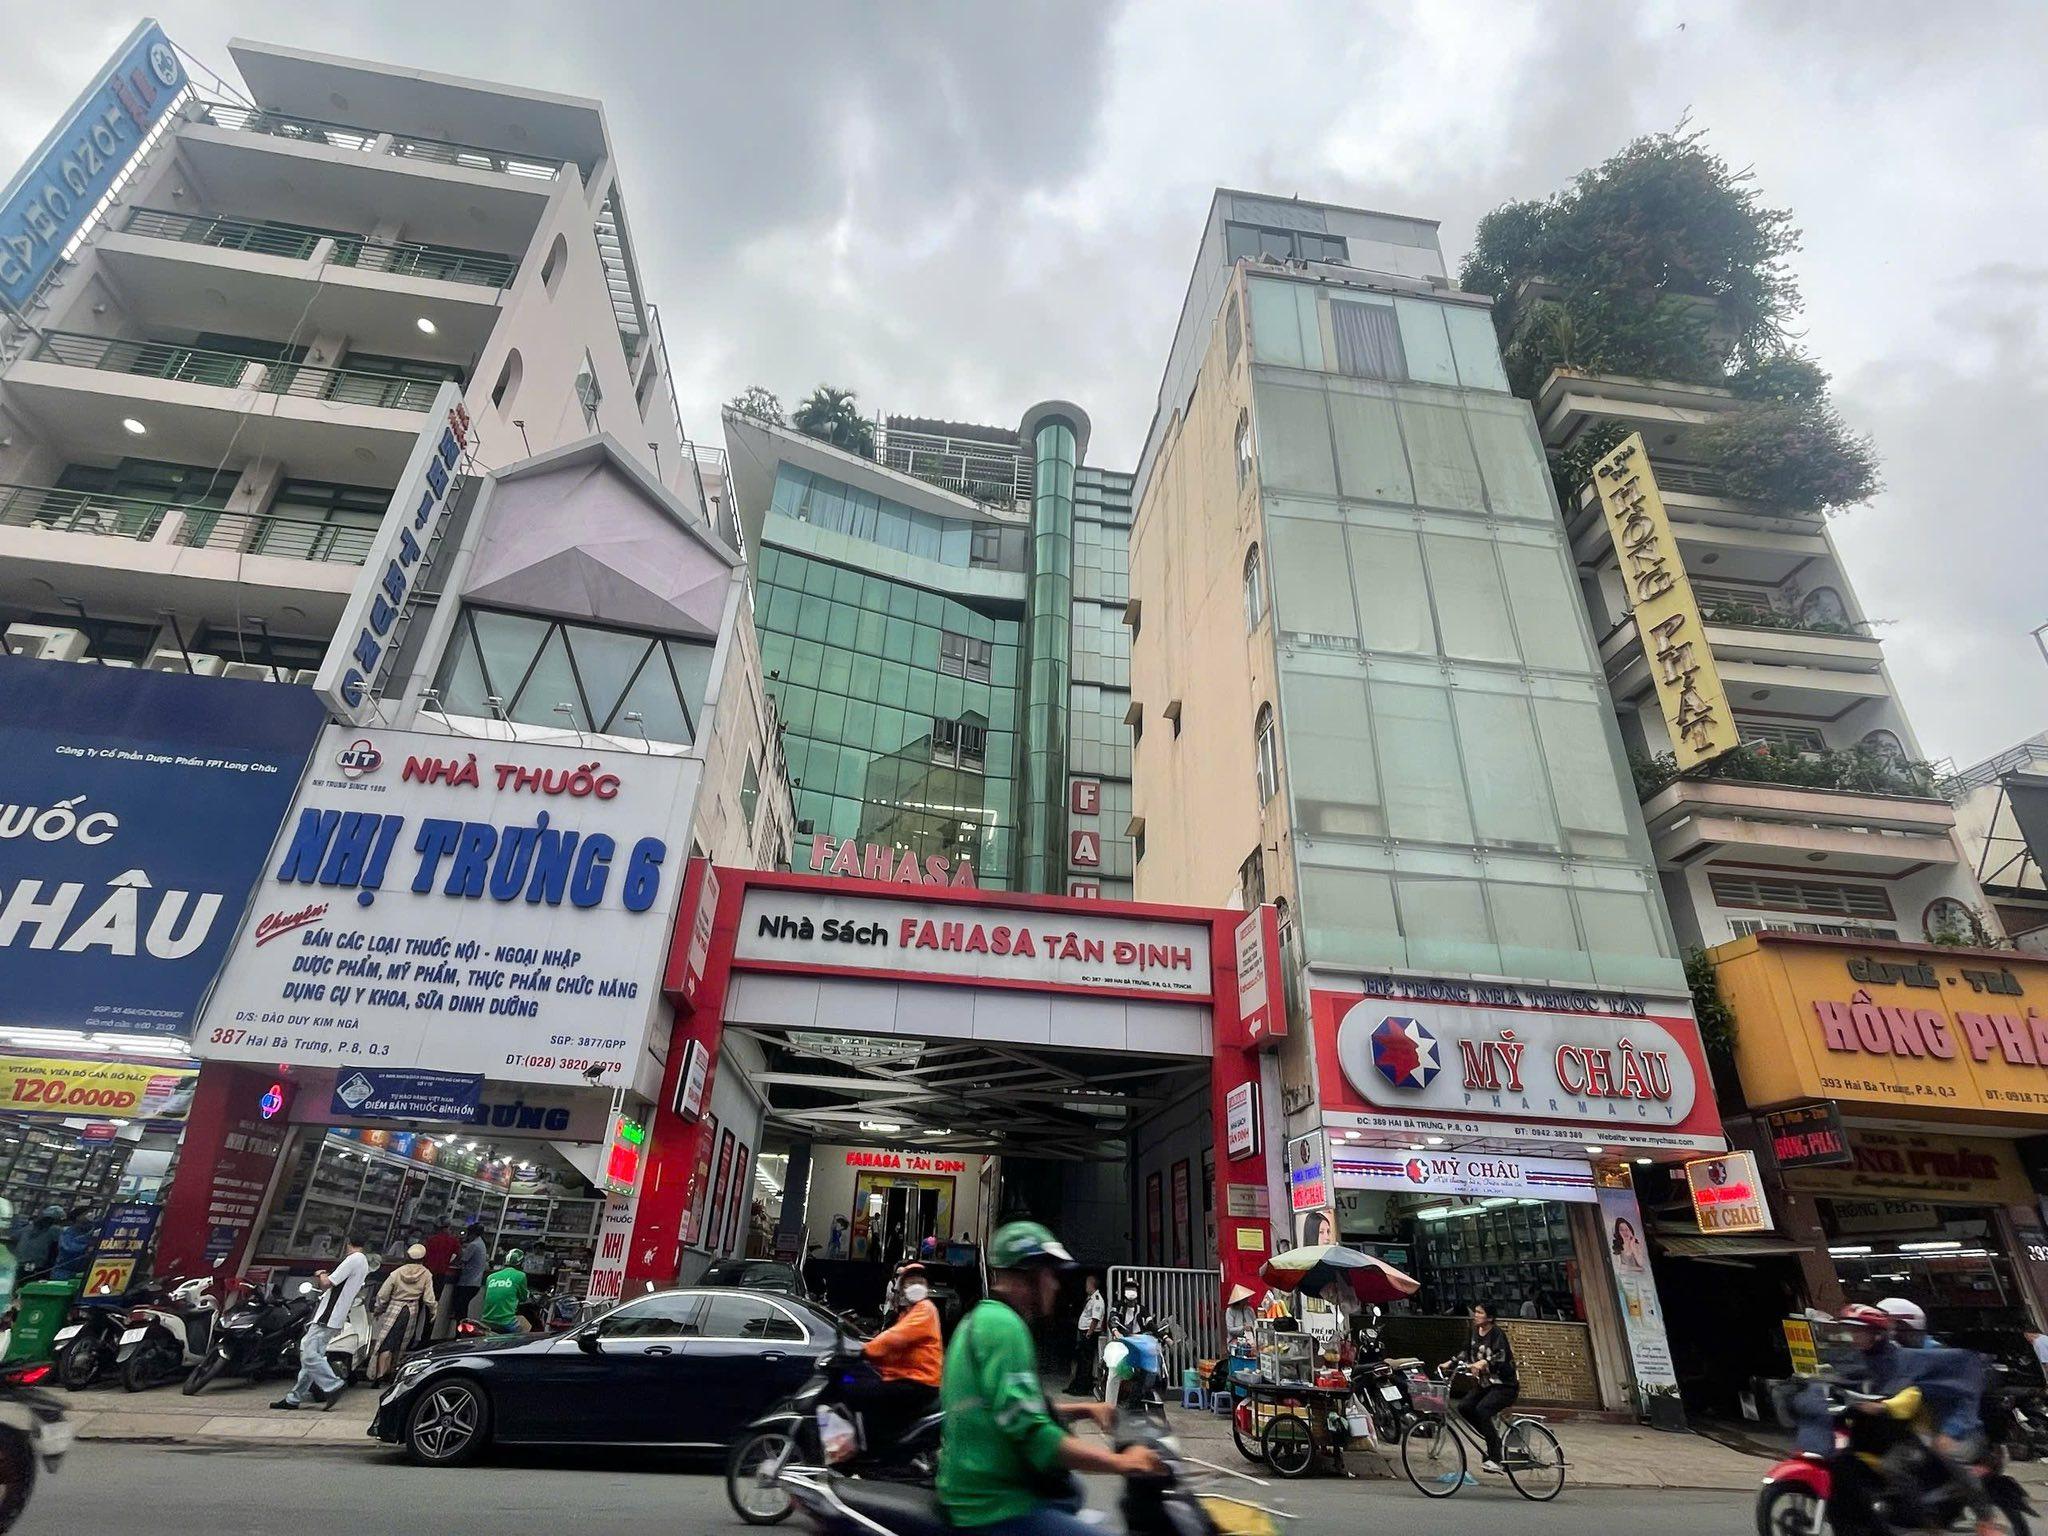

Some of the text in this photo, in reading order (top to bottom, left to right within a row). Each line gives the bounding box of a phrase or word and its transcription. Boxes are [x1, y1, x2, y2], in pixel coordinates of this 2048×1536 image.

[56, 745, 85, 757] Công
[87, 748, 98, 757] Ty
[145, 753, 173, 765] Dược
[206, 760, 223, 768] FPT
[224, 761, 248, 772] Long
[250, 763, 278, 773] Châu
[402, 753, 619, 799] NHÀ THUỐC
[0, 795, 119, 845] UỐC
[277, 808, 666, 911] NHỊ TRƯNG 6
[809, 834, 977, 888] FAHASA
[0, 870, 223, 960] HÂU
[302, 928, 333, 947] BÁN
[336, 931, 364, 950] CÁC
[367, 935, 400, 956] LOẠI
[406, 936, 451, 957] THUỐC
[454, 940, 480, 962] NỘI
[494, 946, 538, 966] NGOẠI
[542, 949, 581, 969] NHẬP
[758, 914, 1192, 972] Nhà Sách FAHASA TÂN ĐỊNH
[292, 955, 333, 976] DƯỢC
[386, 961, 411, 981] MỸ
[468, 970, 505, 990] THỰC
[509, 968, 552, 992] PHẨM
[556, 975, 594, 995] CHỨC
[598, 978, 638, 999] NĂNG
[282, 982, 539, 1017] DỤNG CỤ Y KHOA, SỮA DINH DƯỠNG
[261, 1011, 285, 1024] ĐÀO
[287, 1016, 310, 1025] DUY
[313, 1017, 334, 1027] KIM
[210, 1027, 390, 1056] 387 Hai Bà Trưng, P.8, Q.3
[550, 1035, 626, 1049] SGP: 3877/GPP
[559, 1058, 588, 1070] 3820
[1459, 1029, 1672, 1100] MỸ CHÂU
[11, 1078, 136, 1108] 120.000Đ
[1821, 1078, 1842, 1089] 393
[1845, 1080, 1862, 1091] Hai
[1939, 1086, 1956, 1097] Q.3
[365, 1100, 387, 1110] ĐIỂM
[388, 1101, 407, 1110] BÁN
[409, 1102, 438, 1112] THUỐC
[439, 1104, 460, 1114] BÌNH
[463, 1099, 570, 1130] RƯNG
[1464, 1093, 1672, 1119] PHARMACY
[1357, 1117, 1371, 1125] ĐC:
[1373, 1118, 1386, 1126] 389
[1388, 1119, 1401, 1127] HAI
[1404, 1118, 1414, 1127] BÀ
[1417, 1121, 1446, 1131] TRƯNG,
[1465, 1124, 1479, 1132] Q.3
[1598, 1132, 1695, 1147] Website: www.mychau.com
[845, 1152, 966, 1173] FAHASA TÂN ĐỊNH
[1431, 1157, 1520, 1179] MỸ CHÂU
[606, 1215, 633, 1224] THUỐC
[612, 1204, 630, 1212] NHÀ
[1722, 1203, 1761, 1226] CHÂU
[602, 1233, 625, 1263] NHỊ
[489, 1277, 512, 1288] Grab
